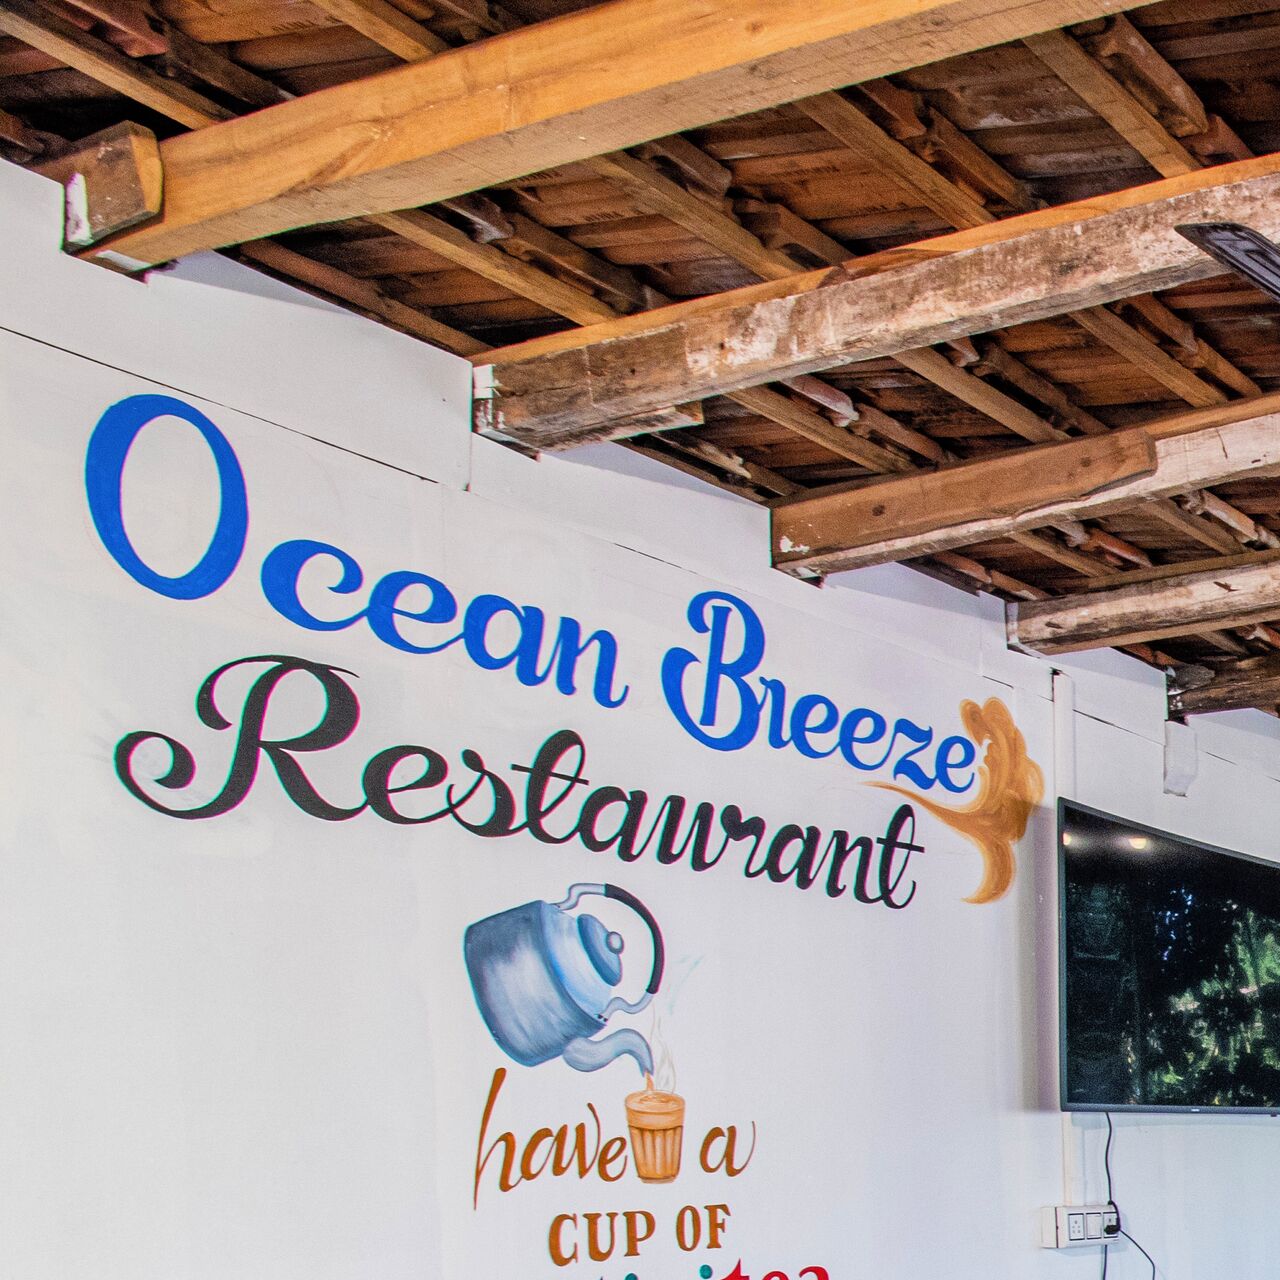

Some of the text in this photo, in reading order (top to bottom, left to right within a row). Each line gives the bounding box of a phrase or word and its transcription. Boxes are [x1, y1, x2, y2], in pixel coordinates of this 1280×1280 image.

[84, 394, 976, 794] Ocean Breeze
[115, 654, 925, 910] Restaurant
[474, 1066, 755, 1210] have a
[548, 1203, 732, 1267] CUP OF
